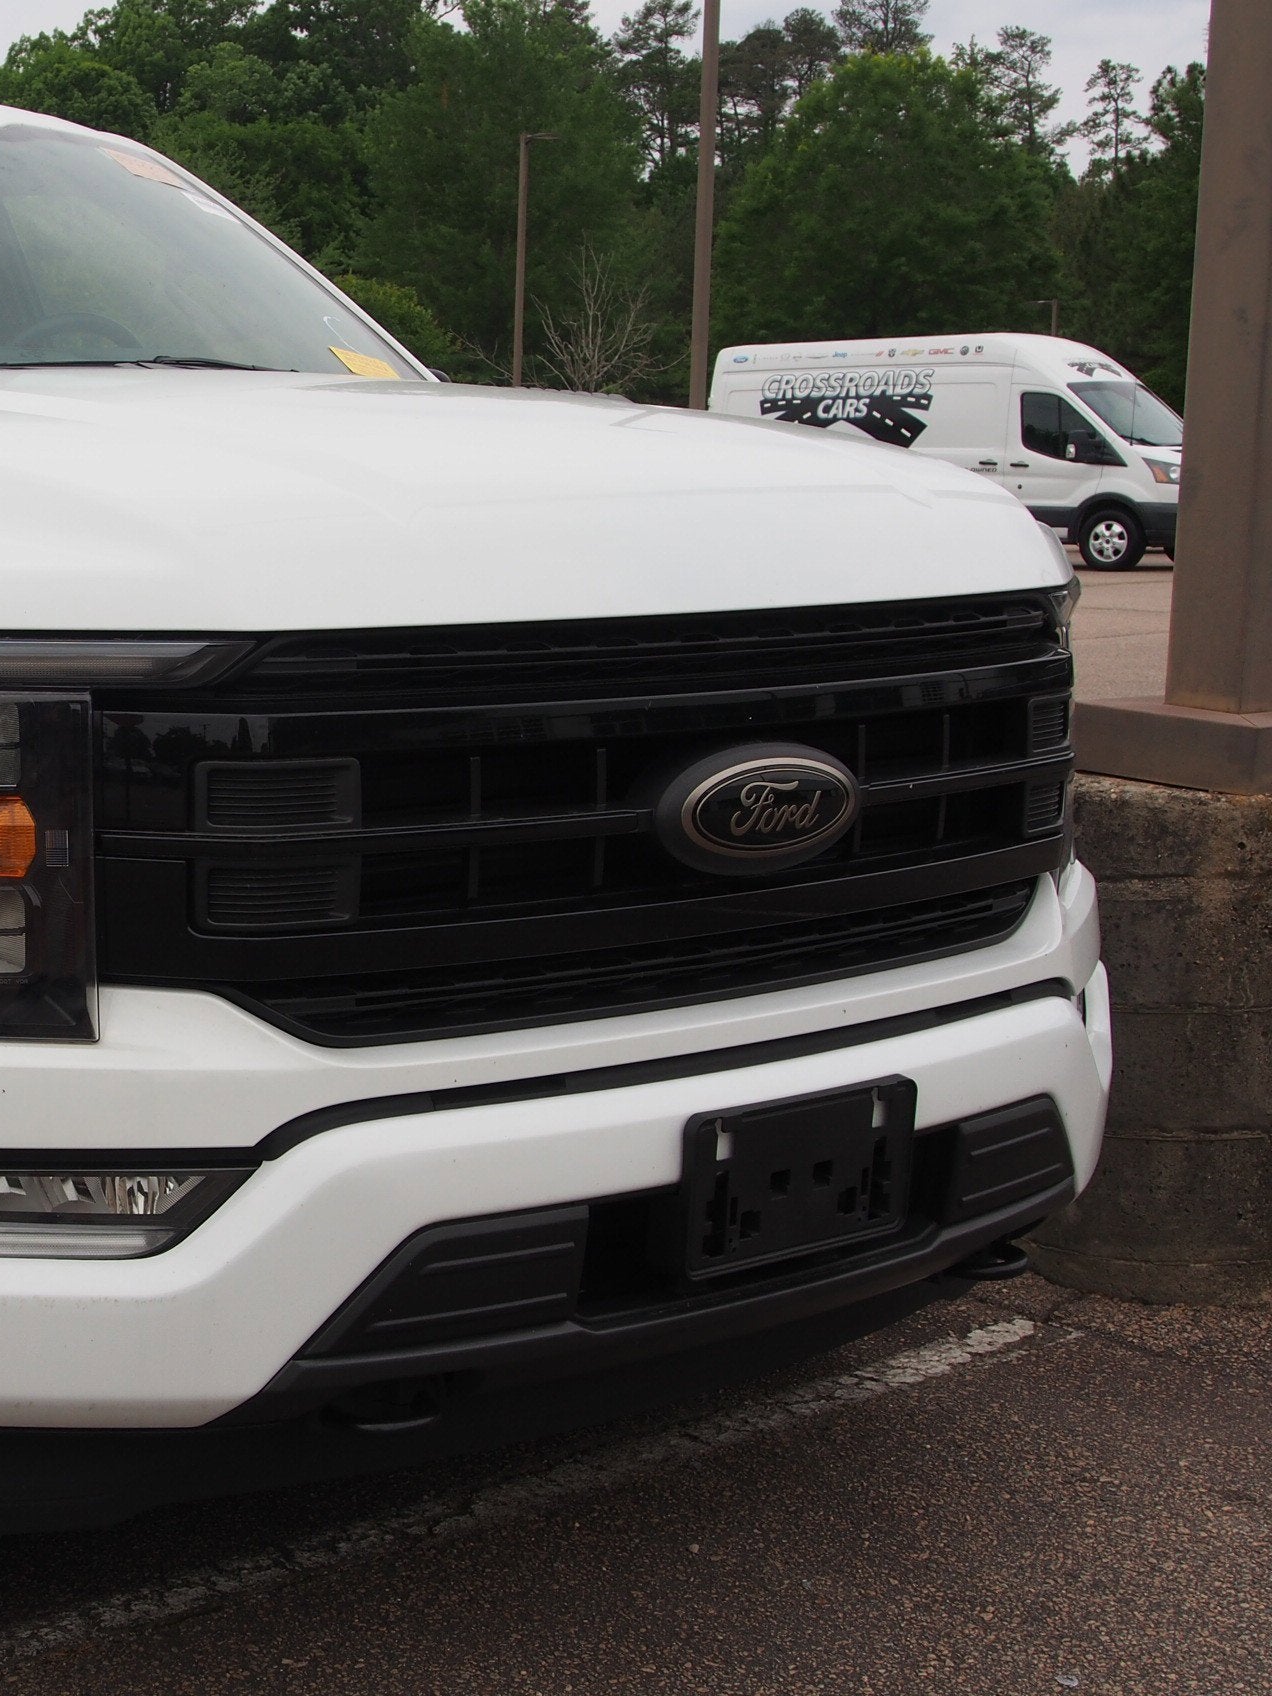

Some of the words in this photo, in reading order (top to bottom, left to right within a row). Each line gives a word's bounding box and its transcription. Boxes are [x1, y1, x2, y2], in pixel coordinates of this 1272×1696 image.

[761, 369, 935, 399] CROSSROADS
[816, 398, 870, 419] CARS
[730, 780, 822, 837] Ford
